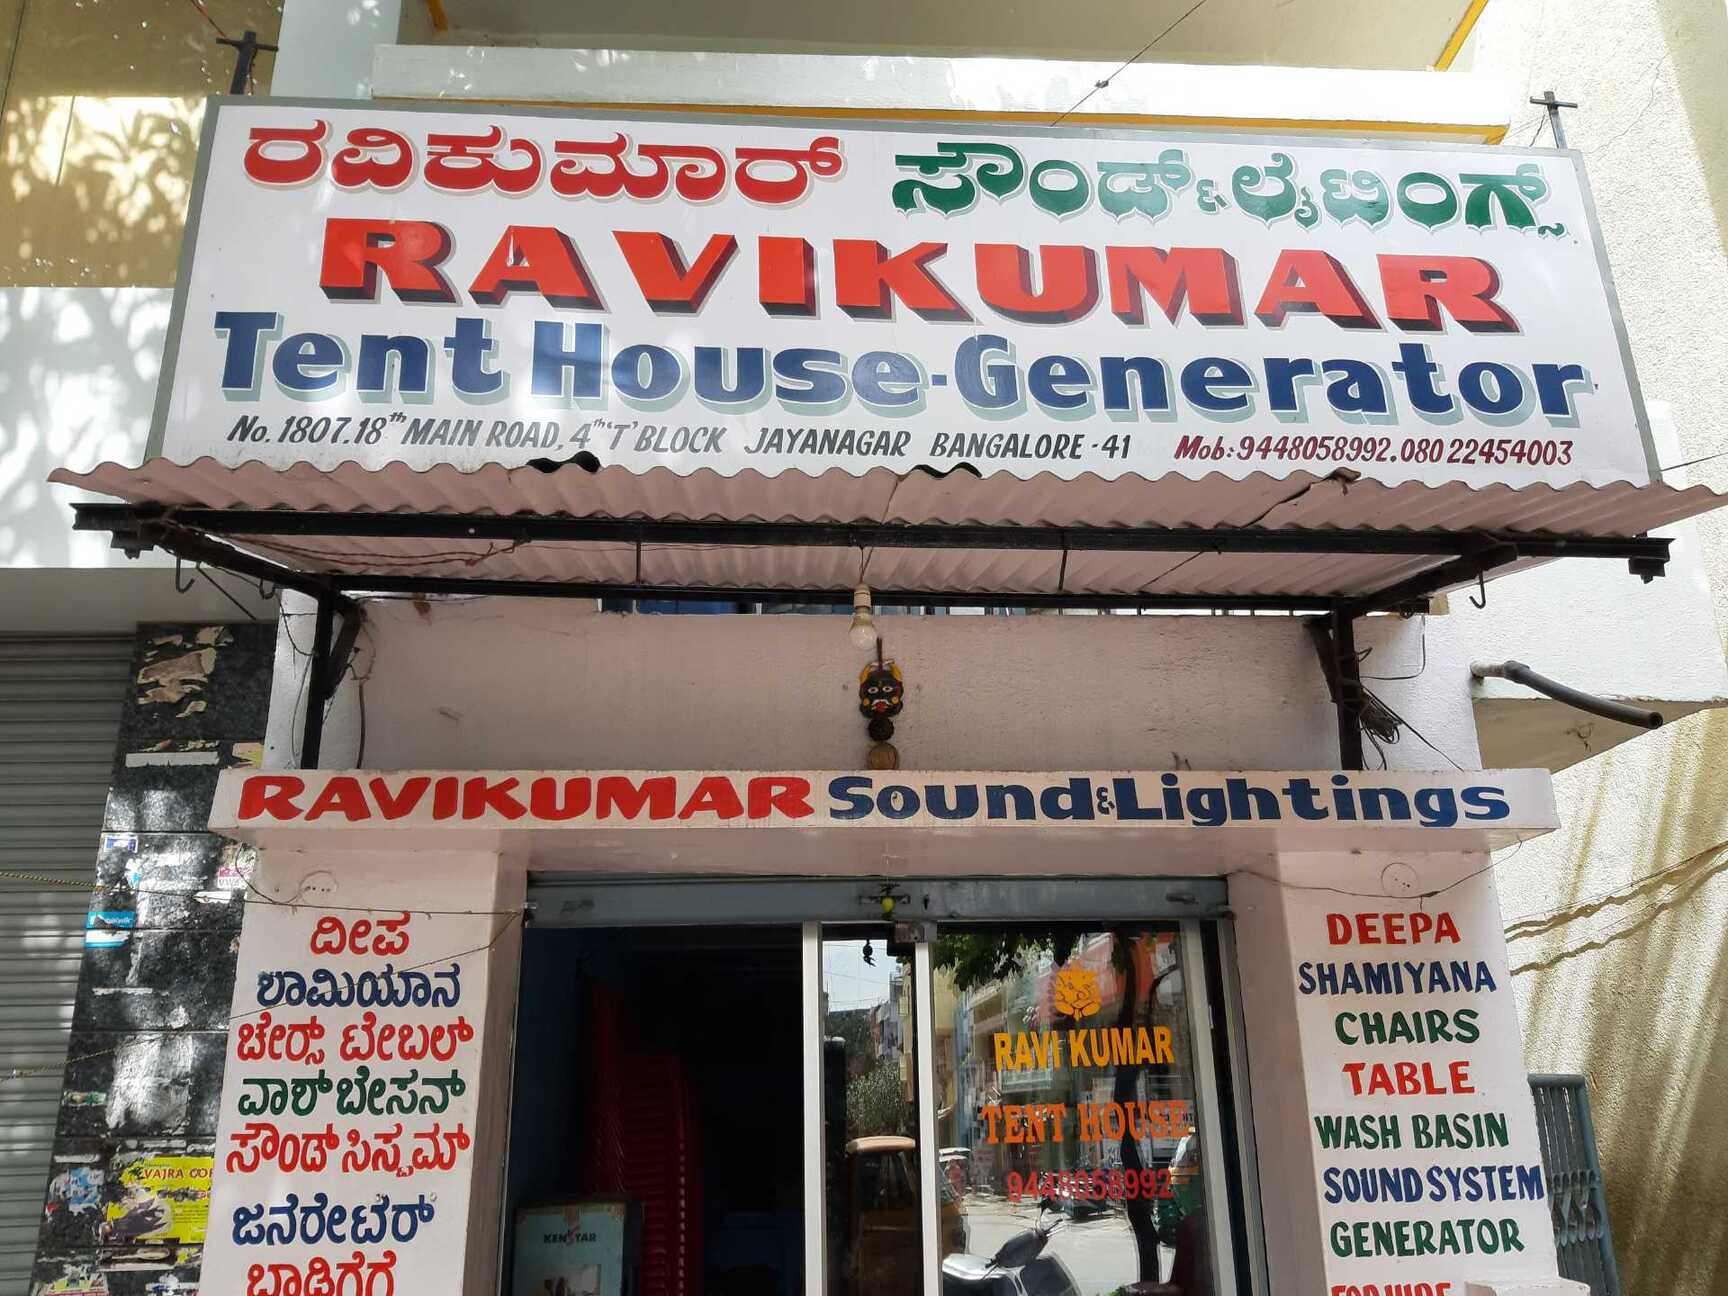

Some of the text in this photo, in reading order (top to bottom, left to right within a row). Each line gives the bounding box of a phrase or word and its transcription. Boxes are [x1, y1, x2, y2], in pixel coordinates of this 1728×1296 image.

[244, 119, 846, 204] ರವಿಕುಮಾರ್
[892, 142, 1193, 222] ಸೌಂಡ್
[319, 218, 1522, 334] RAVIKUMAR
[213, 311, 506, 408] Tent
[401, 418, 483, 446] MAIN
[485, 421, 563, 450] ROAD,
[633, 425, 727, 453] BLOCK
[744, 427, 911, 457] JAYANAGAR
[930, 432, 1085, 459] BANGALORE
[1446, 438, 1573, 466] 22454003
[237, 775, 816, 821] RAVIKUMAR
[310, 911, 411, 956] ದೀಪ
[1326, 912, 1461, 945] DEEPA
[256, 963, 461, 1008] ಶಾಮಿಯಾನ
[1299, 960, 1497, 995] SHAMIYANA
[237, 1011, 474, 1065] ಚೇರ್ಸ್ ಟೇಬಲ್
[1335, 1008, 1480, 1046] CHAIRS
[993, 1025, 1175, 1073] RAVI KUMAR
[238, 1066, 466, 1116] ವಾಶ್ ಬೇಸನ್
[1342, 1061, 1475, 1096] TABLE
[981, 1099, 1191, 1145] TENT HOUSE
[1314, 1112, 1509, 1150] WASH BASIN
[226, 1122, 471, 1178] ಸೌಂಡ್ ಸಿಸ್ಟಮ್
[143, 1167, 184, 1180] VAJRA
[1006, 1166, 1176, 1203] 9448058992
[1323, 1165, 1546, 1204] SOUND SYSTEM
[1330, 1218, 1525, 1258] GENERATOR
